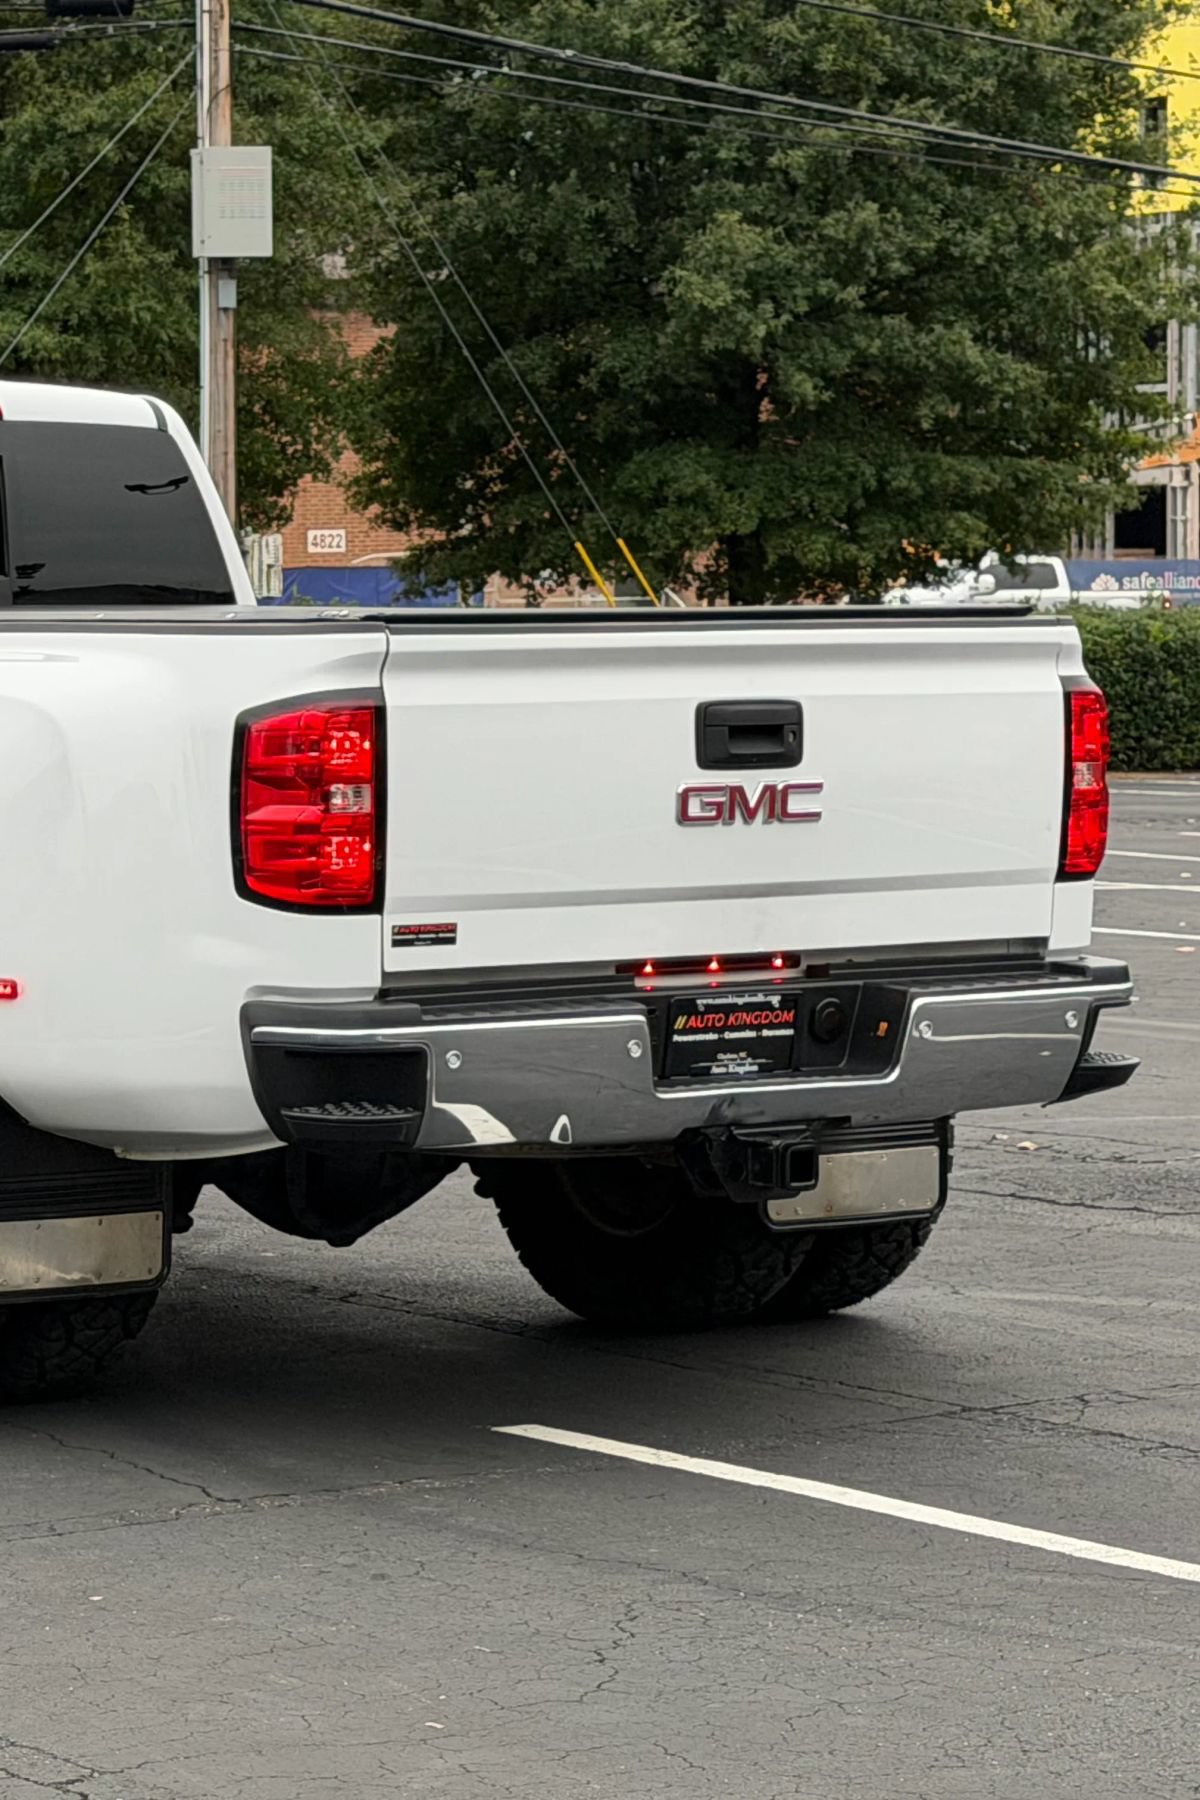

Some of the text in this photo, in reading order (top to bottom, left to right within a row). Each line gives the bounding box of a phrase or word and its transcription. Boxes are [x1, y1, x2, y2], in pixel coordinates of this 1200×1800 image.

[310, 533, 343, 549] 4822
[676, 779, 824, 827] GMC
[687, 1009, 795, 1029] AUTO KINGDOM
